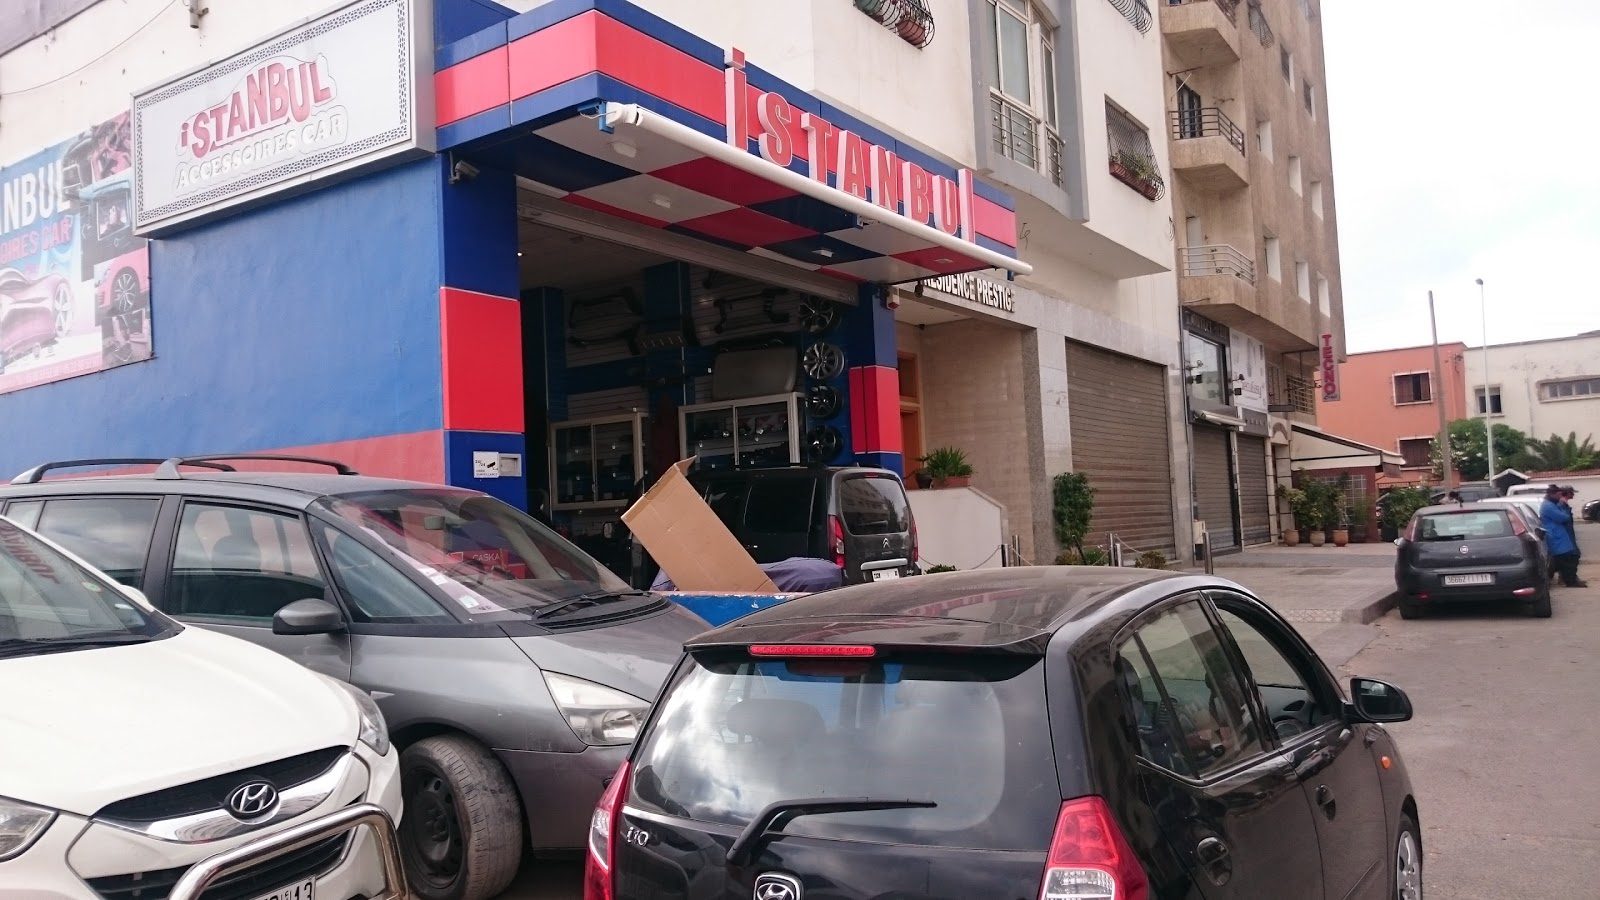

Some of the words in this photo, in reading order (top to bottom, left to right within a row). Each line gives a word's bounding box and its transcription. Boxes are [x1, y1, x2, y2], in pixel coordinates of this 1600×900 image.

[301, 113, 345, 145] CAR
[1322, 334, 1336, 394] TECNO
[626, 826, 649, 847] i10
